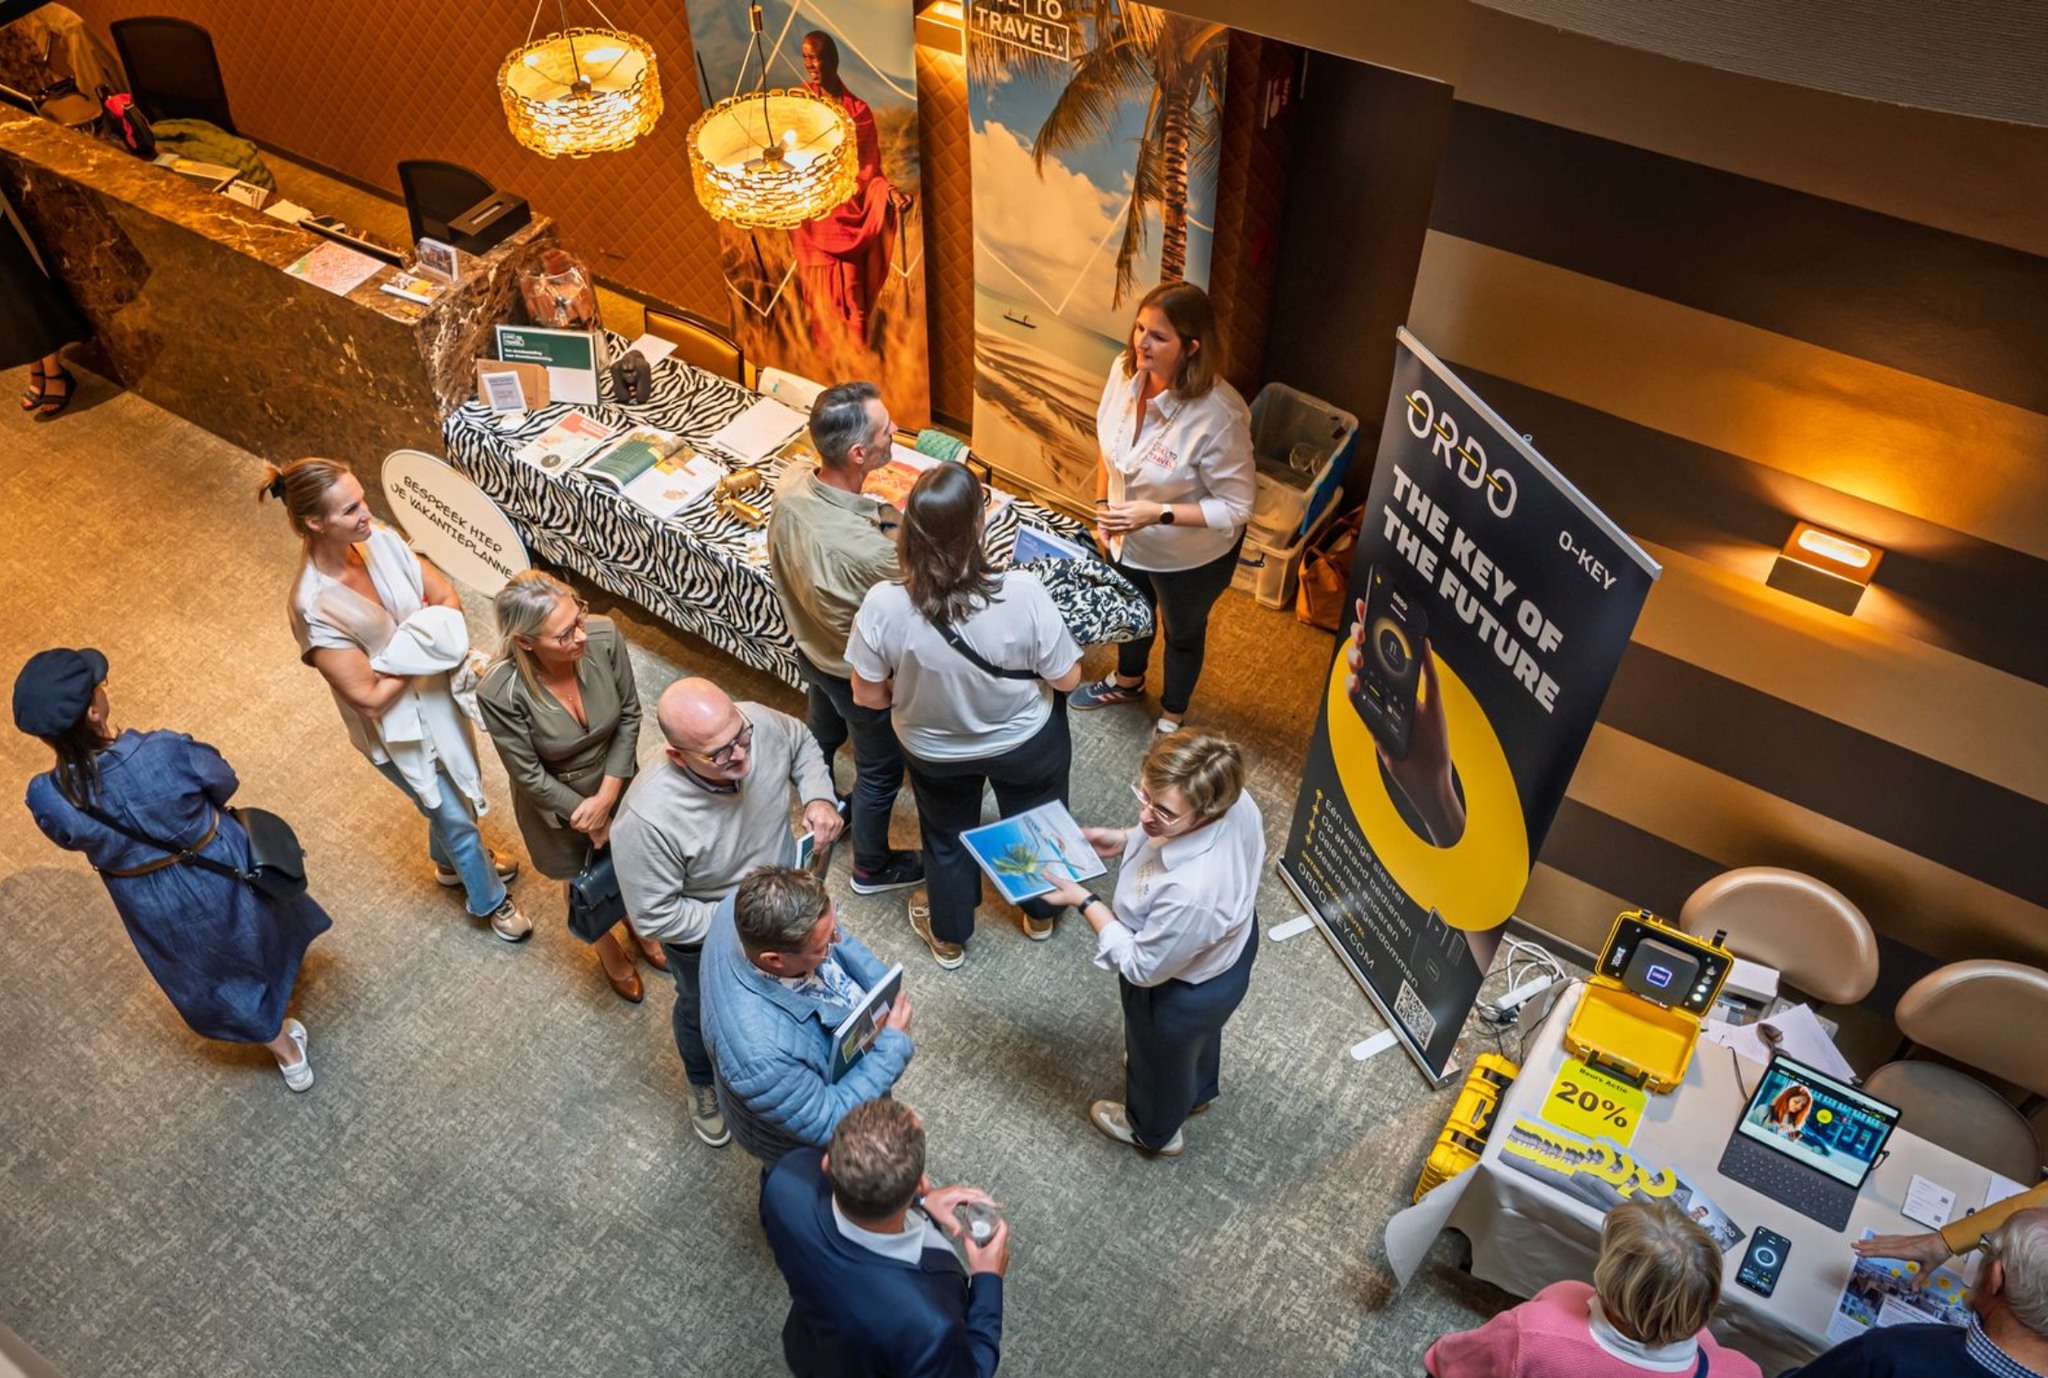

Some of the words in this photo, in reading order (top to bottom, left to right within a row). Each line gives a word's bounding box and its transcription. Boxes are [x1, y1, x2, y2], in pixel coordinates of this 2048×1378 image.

[975, 6, 1063, 52] TRAVEL.
[1036, 0, 1063, 20] TO
[1405, 389, 1518, 519] ORDO
[390, 482, 407, 500] JE
[410, 495, 514, 580] VAKANTIEPLANNE
[404, 475, 468, 529] BESPREEK
[469, 525, 503, 555] HIER
[1393, 465, 1450, 541] THE
[1450, 526, 1518, 607] KEY
[1516, 599, 1564, 653] OF
[1558, 530, 1617, 591] O-KEY
[1383, 504, 1439, 584] THE
[1438, 565, 1561, 714] FUTURE
[1317, 830, 1342, 866] Delen
[1343, 865, 1361, 890] met
[1362, 890, 1399, 941] anderen
[1321, 815, 1334, 834] Op
[1334, 833, 1369, 879] afstand
[1369, 877, 1412, 937] bedienen
[1343, 822, 1372, 863] veilige
[1373, 862, 1404, 905] sleutel
[1314, 845, 1354, 902] Meerdere
[1355, 900, 1418, 988] eigendommen
[1555, 1081, 1628, 1128] 20%
[1579, 1068, 1604, 1083] Beurs
[1605, 1080, 1628, 1094] Actie
